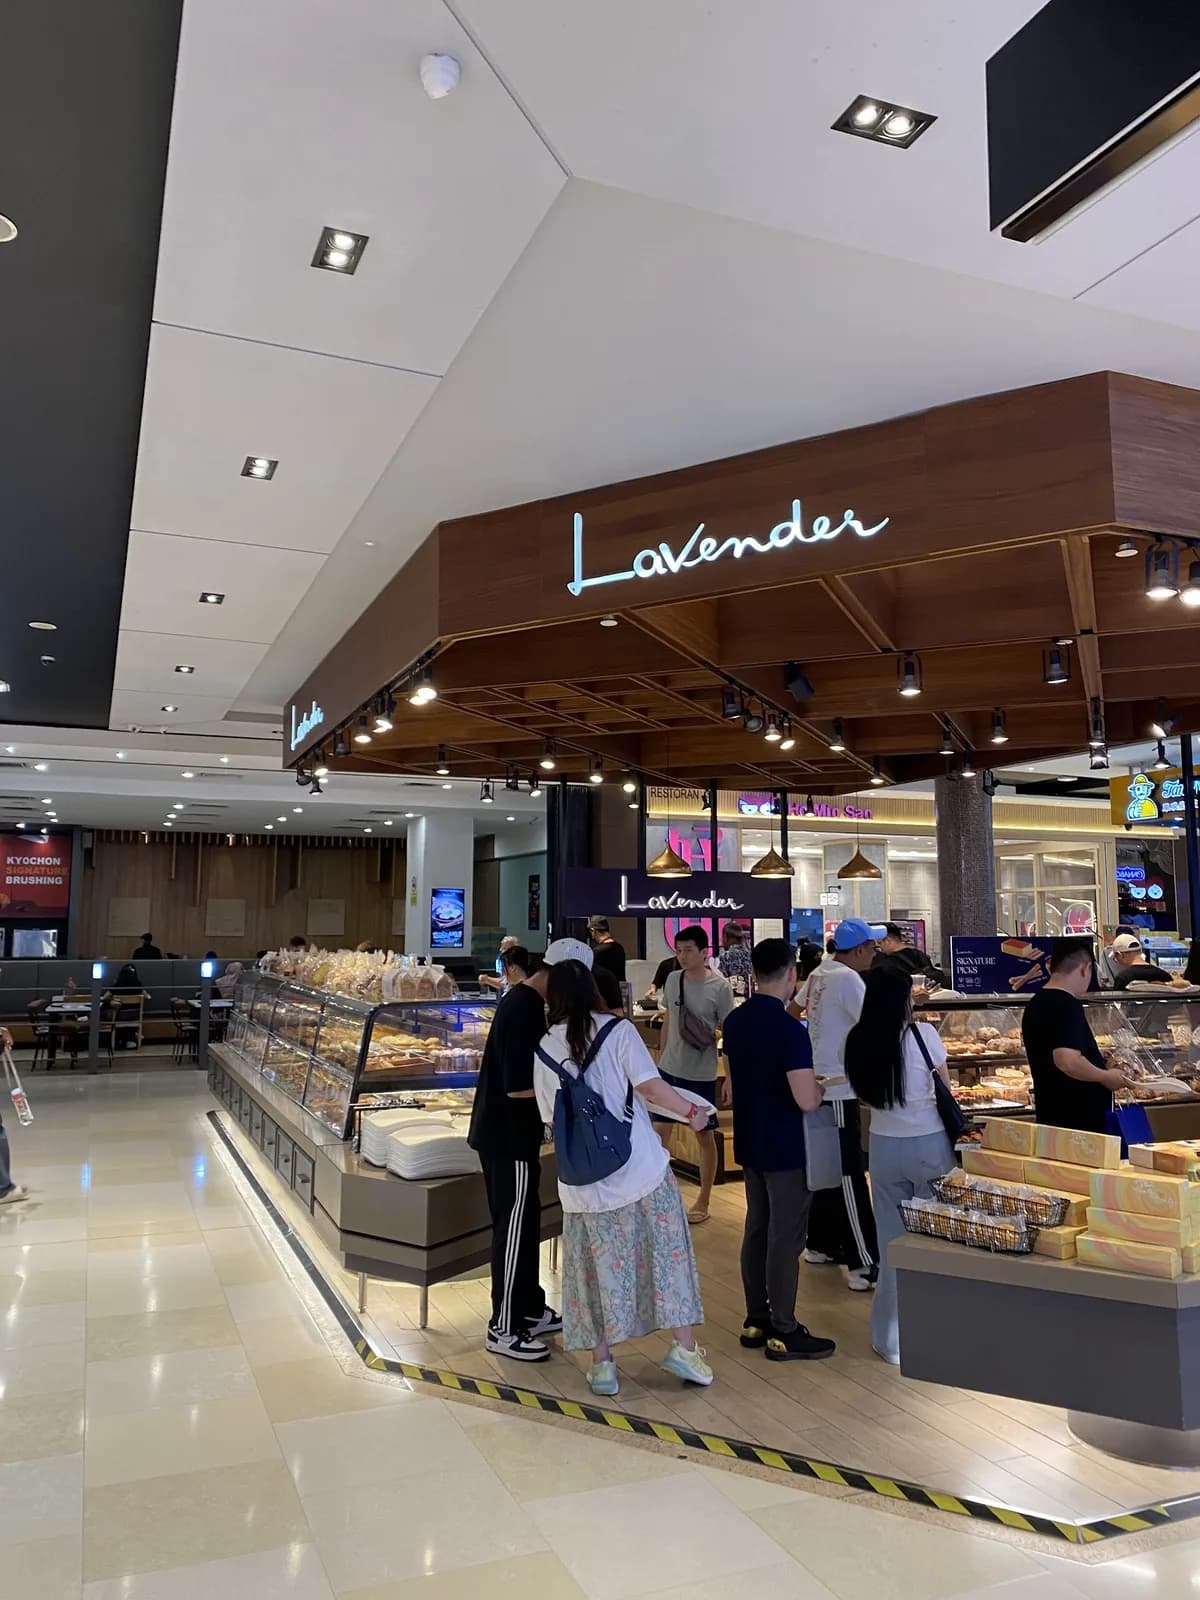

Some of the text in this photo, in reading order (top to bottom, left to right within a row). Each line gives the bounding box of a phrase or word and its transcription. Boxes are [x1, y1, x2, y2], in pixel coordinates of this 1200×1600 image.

[566, 498, 890, 597] Lavender
[650, 787, 699, 799] RESTORAN
[844, 803, 873, 820] San
[6, 856, 61, 865] KYOCHON
[6, 866, 66, 875] SIGNATURE
[5, 876, 63, 885] BRUSHING
[618, 874, 744, 912] Lavender
[956, 957, 996, 965] SIGNATURE
[956, 966, 978, 975] PICKS
